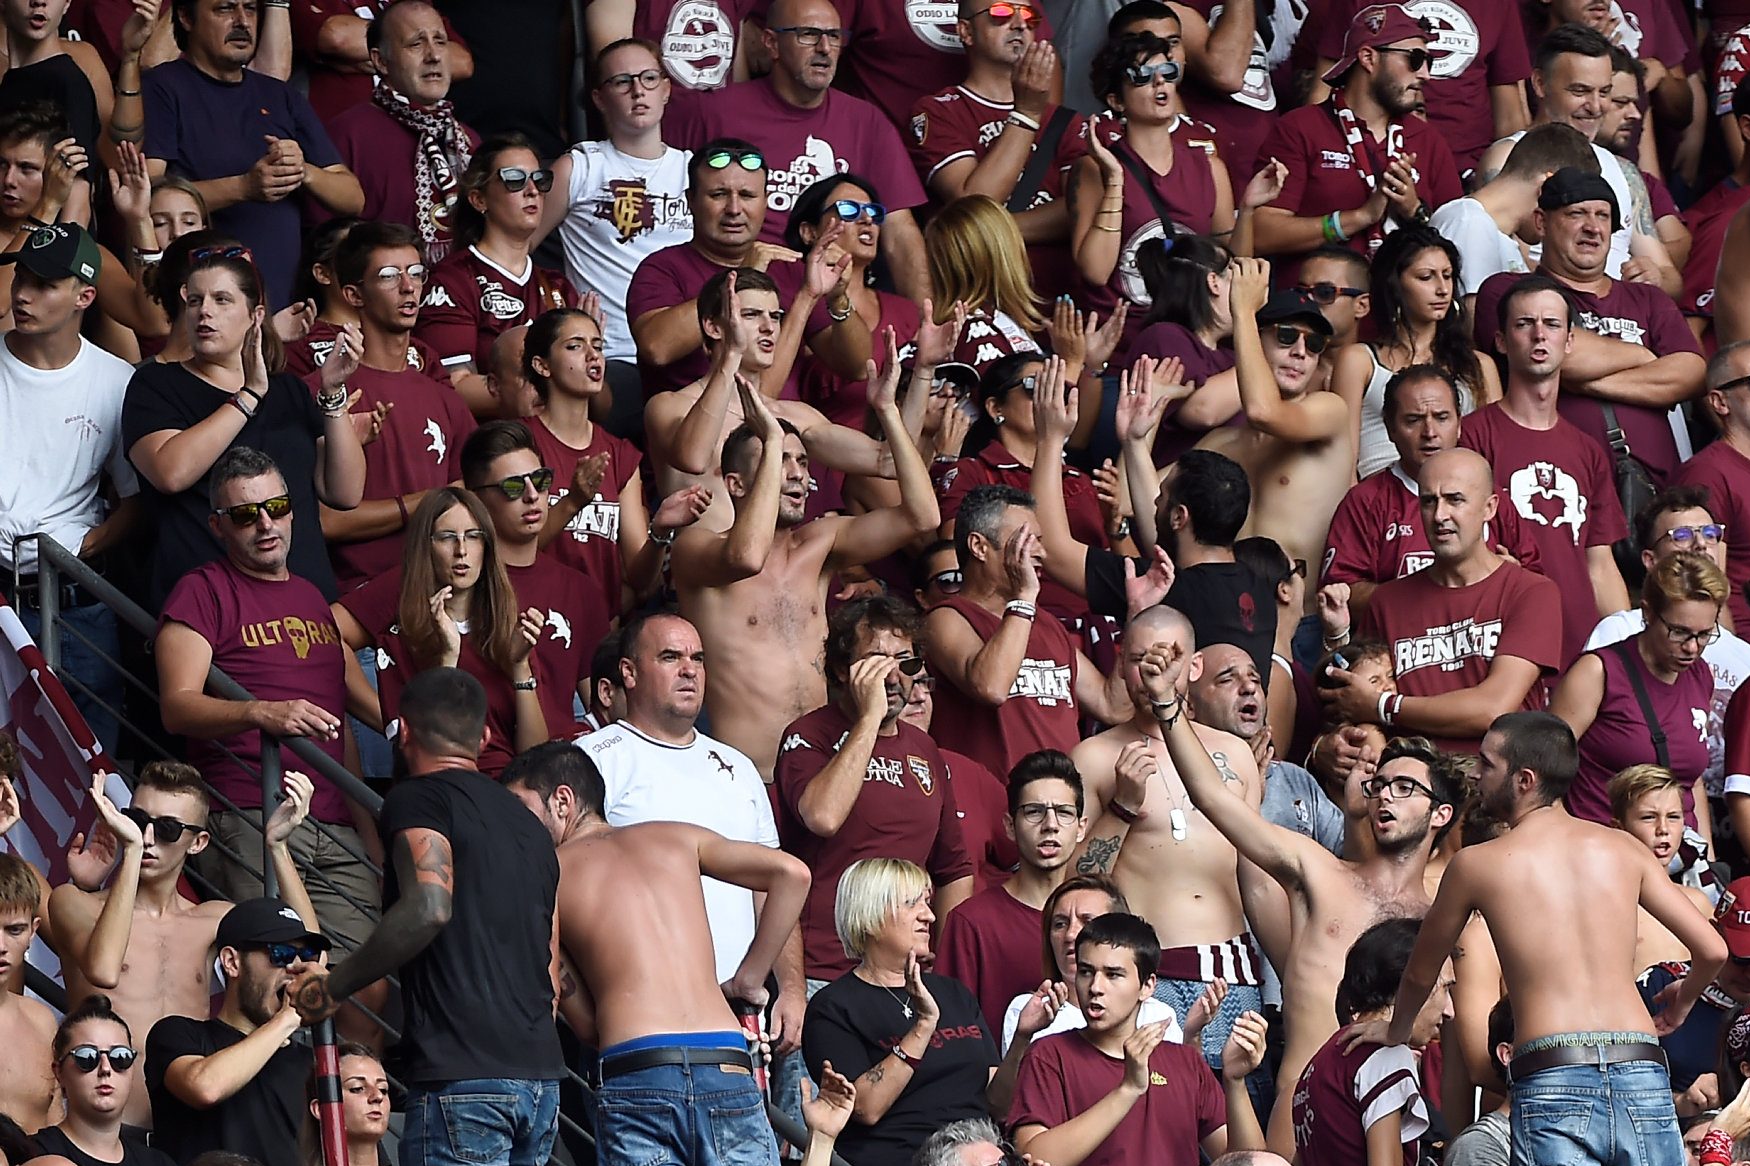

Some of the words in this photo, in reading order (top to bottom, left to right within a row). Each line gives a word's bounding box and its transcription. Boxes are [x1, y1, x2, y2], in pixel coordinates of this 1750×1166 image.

[915, 9, 943, 19] ODIO
[1442, 37, 1470, 49] JUVE
[1426, 625, 1452, 637] TORO
[1396, 622, 1502, 675] RENATE
